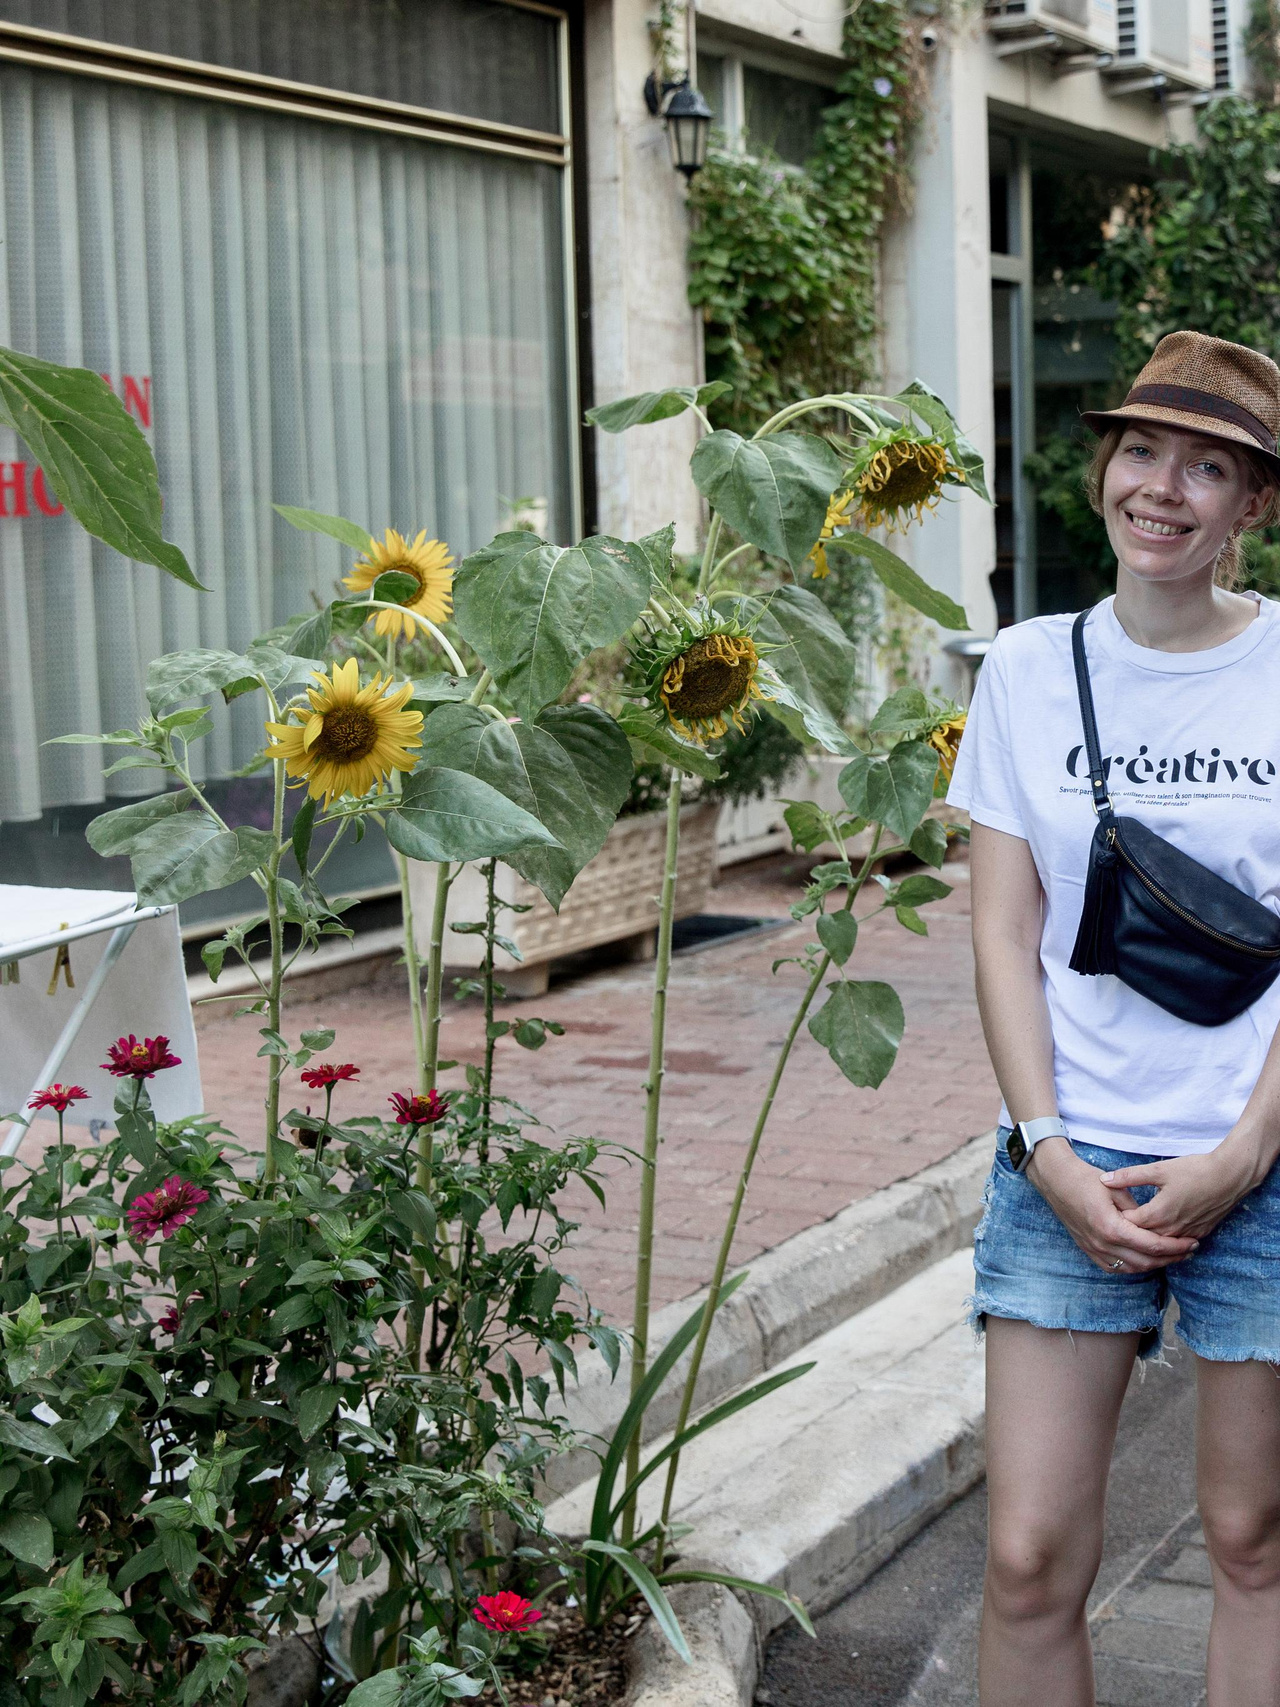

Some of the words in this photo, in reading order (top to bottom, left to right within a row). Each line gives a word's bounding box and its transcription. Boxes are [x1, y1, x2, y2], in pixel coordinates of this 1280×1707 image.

[1066, 745, 1276, 784] Créative
[1059, 786, 1078, 794] Savoir
[1193, 792, 1230, 800] imagination
